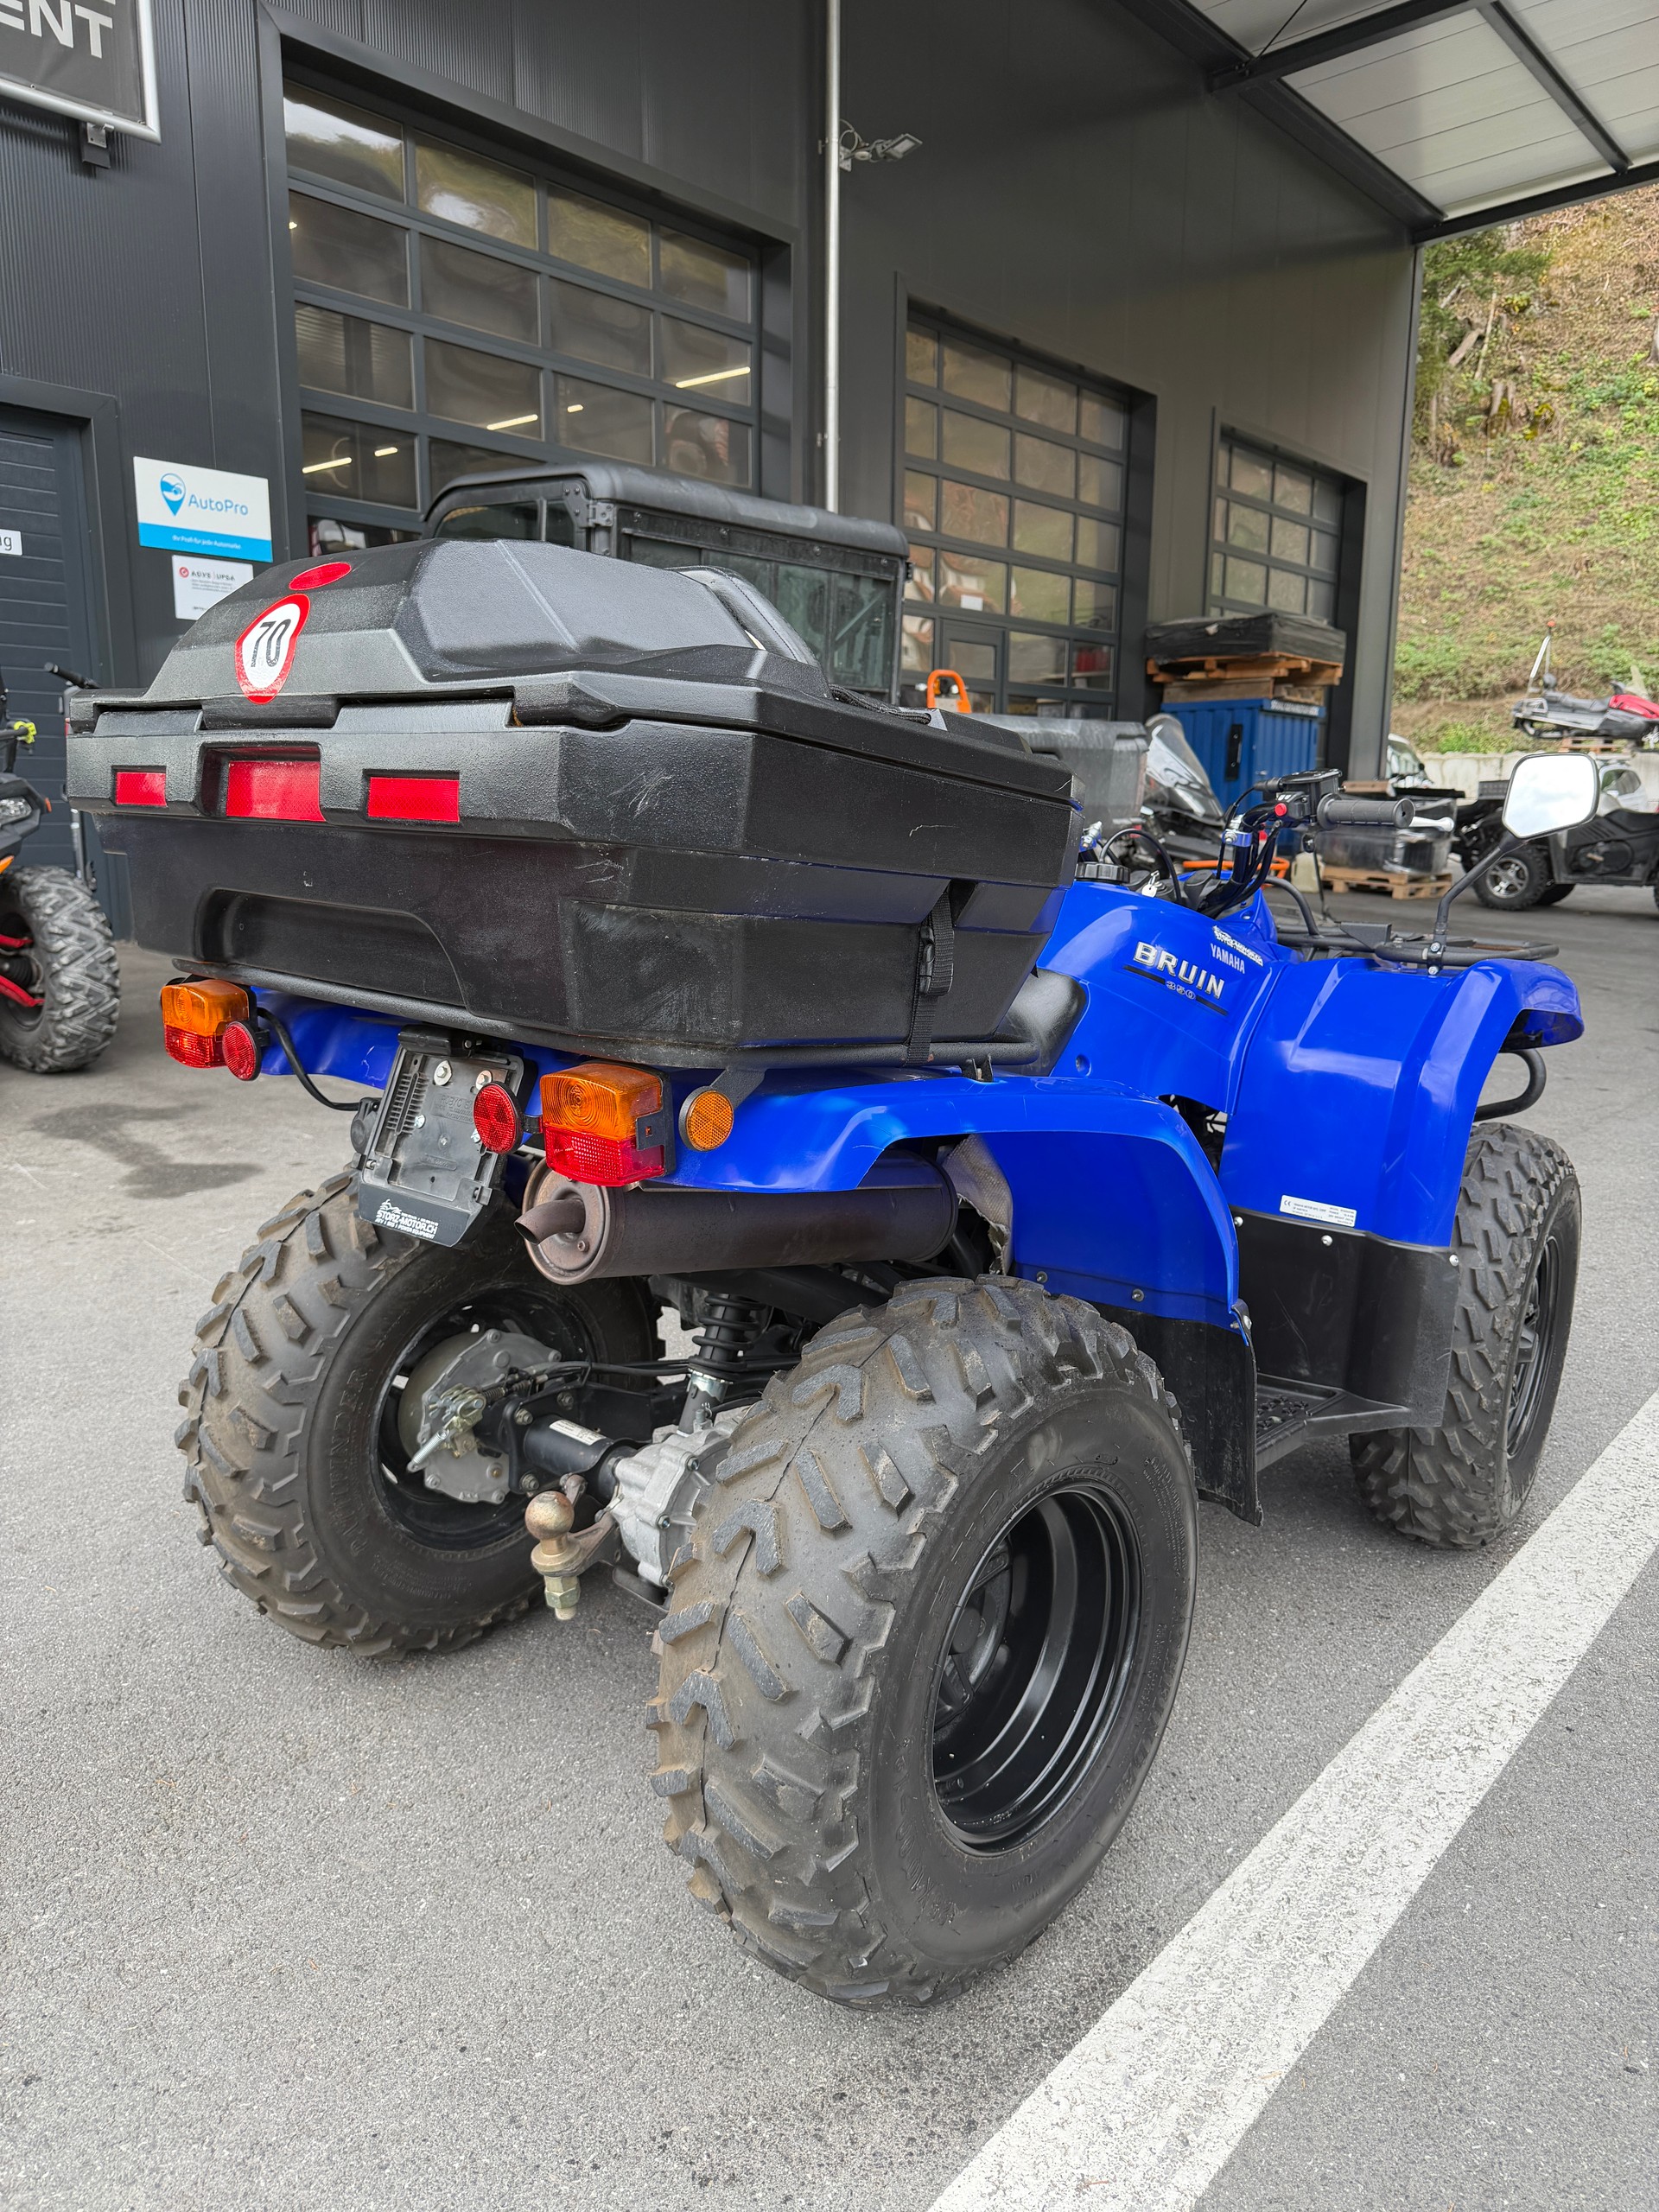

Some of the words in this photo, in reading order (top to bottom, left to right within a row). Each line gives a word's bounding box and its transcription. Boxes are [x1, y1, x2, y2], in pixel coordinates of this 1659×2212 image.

[188, 494, 249, 516] AutoPro
[251, 619, 291, 667] 70
[1133, 940, 1225, 1000] BRUIN
[1210, 943, 1245, 975] YAMAHA
[1166, 980, 1197, 1001] 350
[375, 1209, 438, 1235] STORZ-MOTOR.CH
